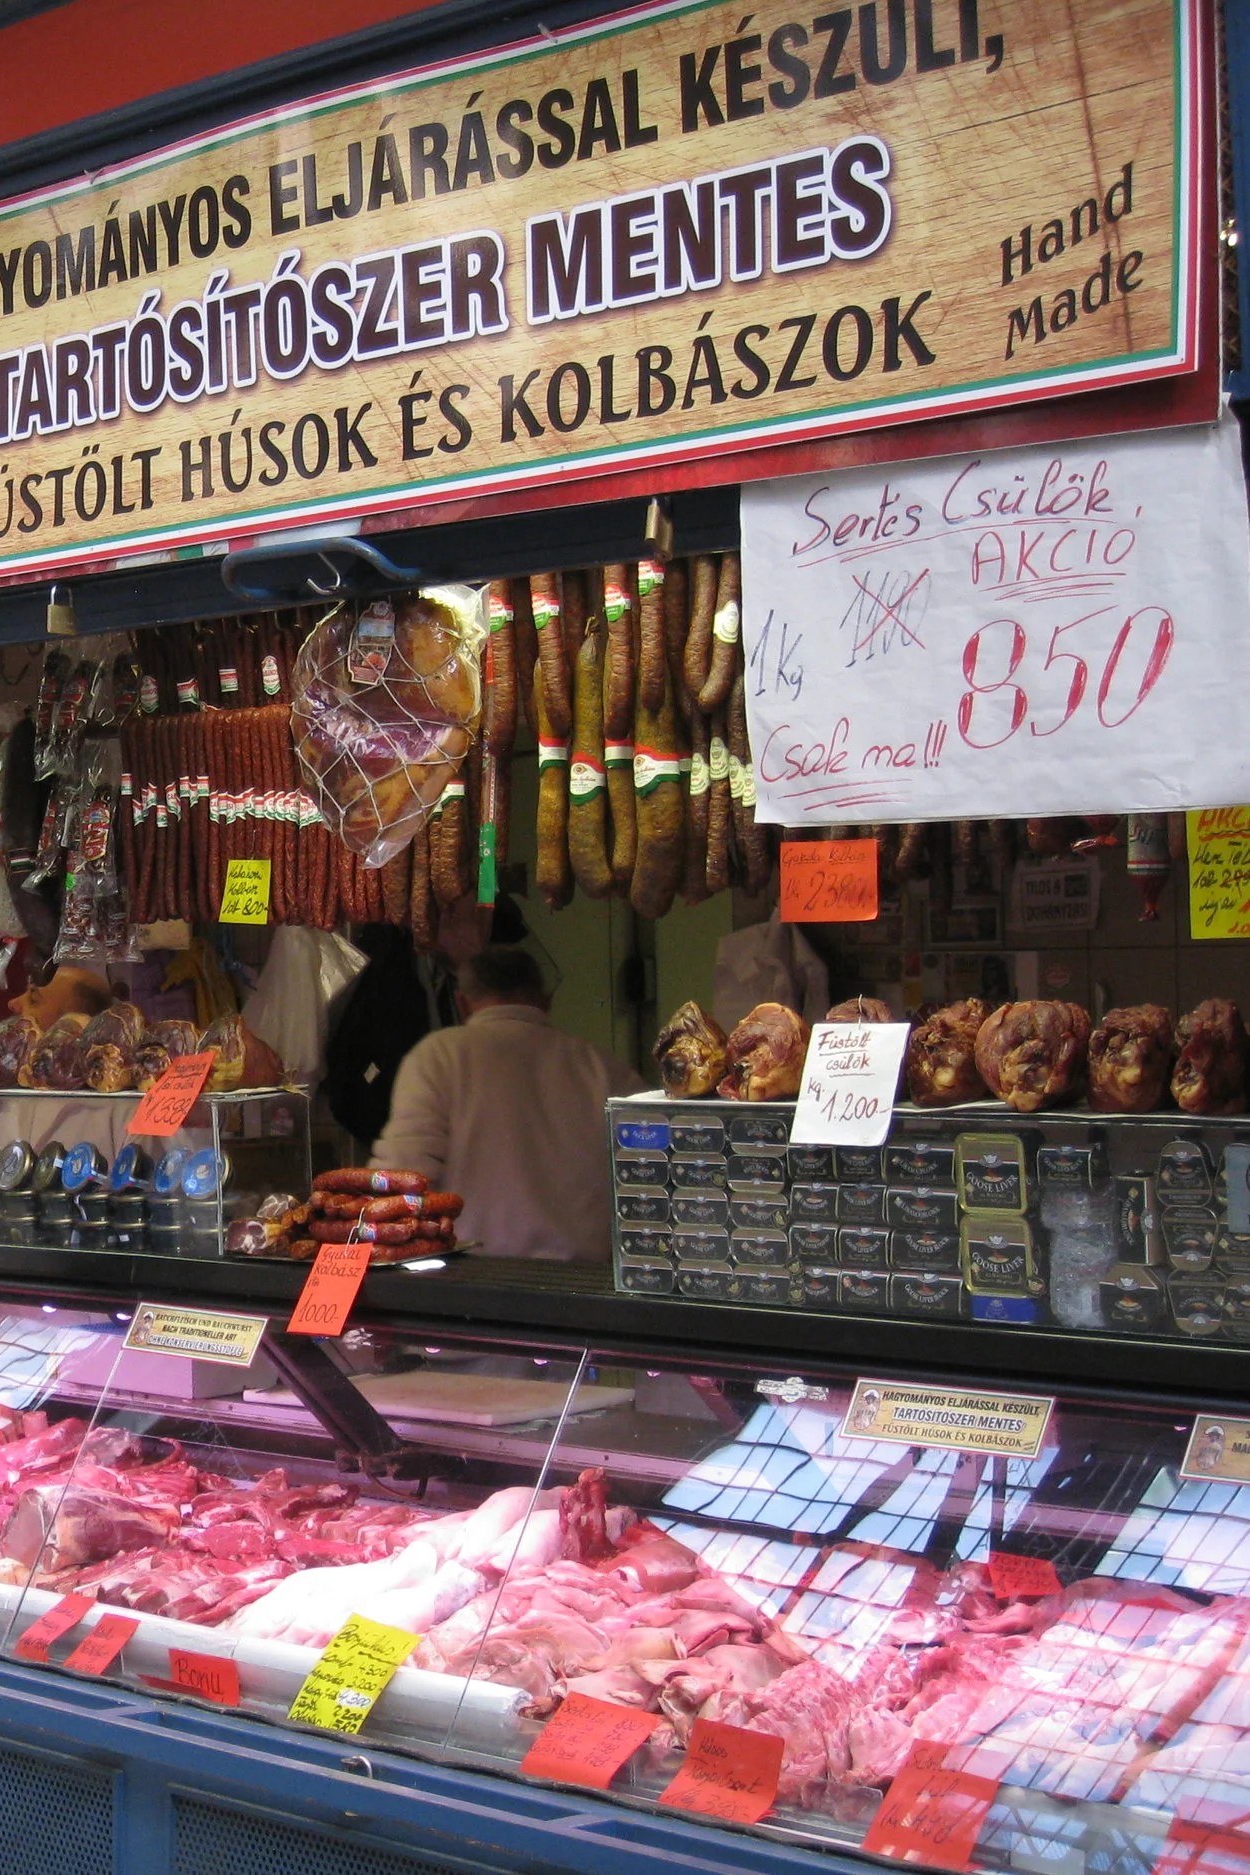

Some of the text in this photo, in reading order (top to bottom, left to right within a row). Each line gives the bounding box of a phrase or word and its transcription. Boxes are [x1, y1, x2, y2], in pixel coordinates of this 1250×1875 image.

[269, 70, 659, 237] ELJÁRÁSSAL
[526, 135, 891, 325] MENTES
[999, 160, 1134, 287] Hand
[1003, 249, 1145, 361] Made
[179, 401, 377, 503] HÚSOK
[400, 370, 472, 462] ÉS
[498, 290, 936, 445] KOLBÁSZOK
[957, 604, 1176, 750] 850
[759, 717, 850, 785] Csak
[966, 1170, 1019, 1193] GOOSE LIVER
[971, 1250, 1025, 1274] GOOSE LIVER
[882, 1390, 947, 1407] HAGYOMÁNYOS
[947, 1395, 1001, 1413] ELJÁRÁSSAL
[976, 1415, 1024, 1433] MENTES
